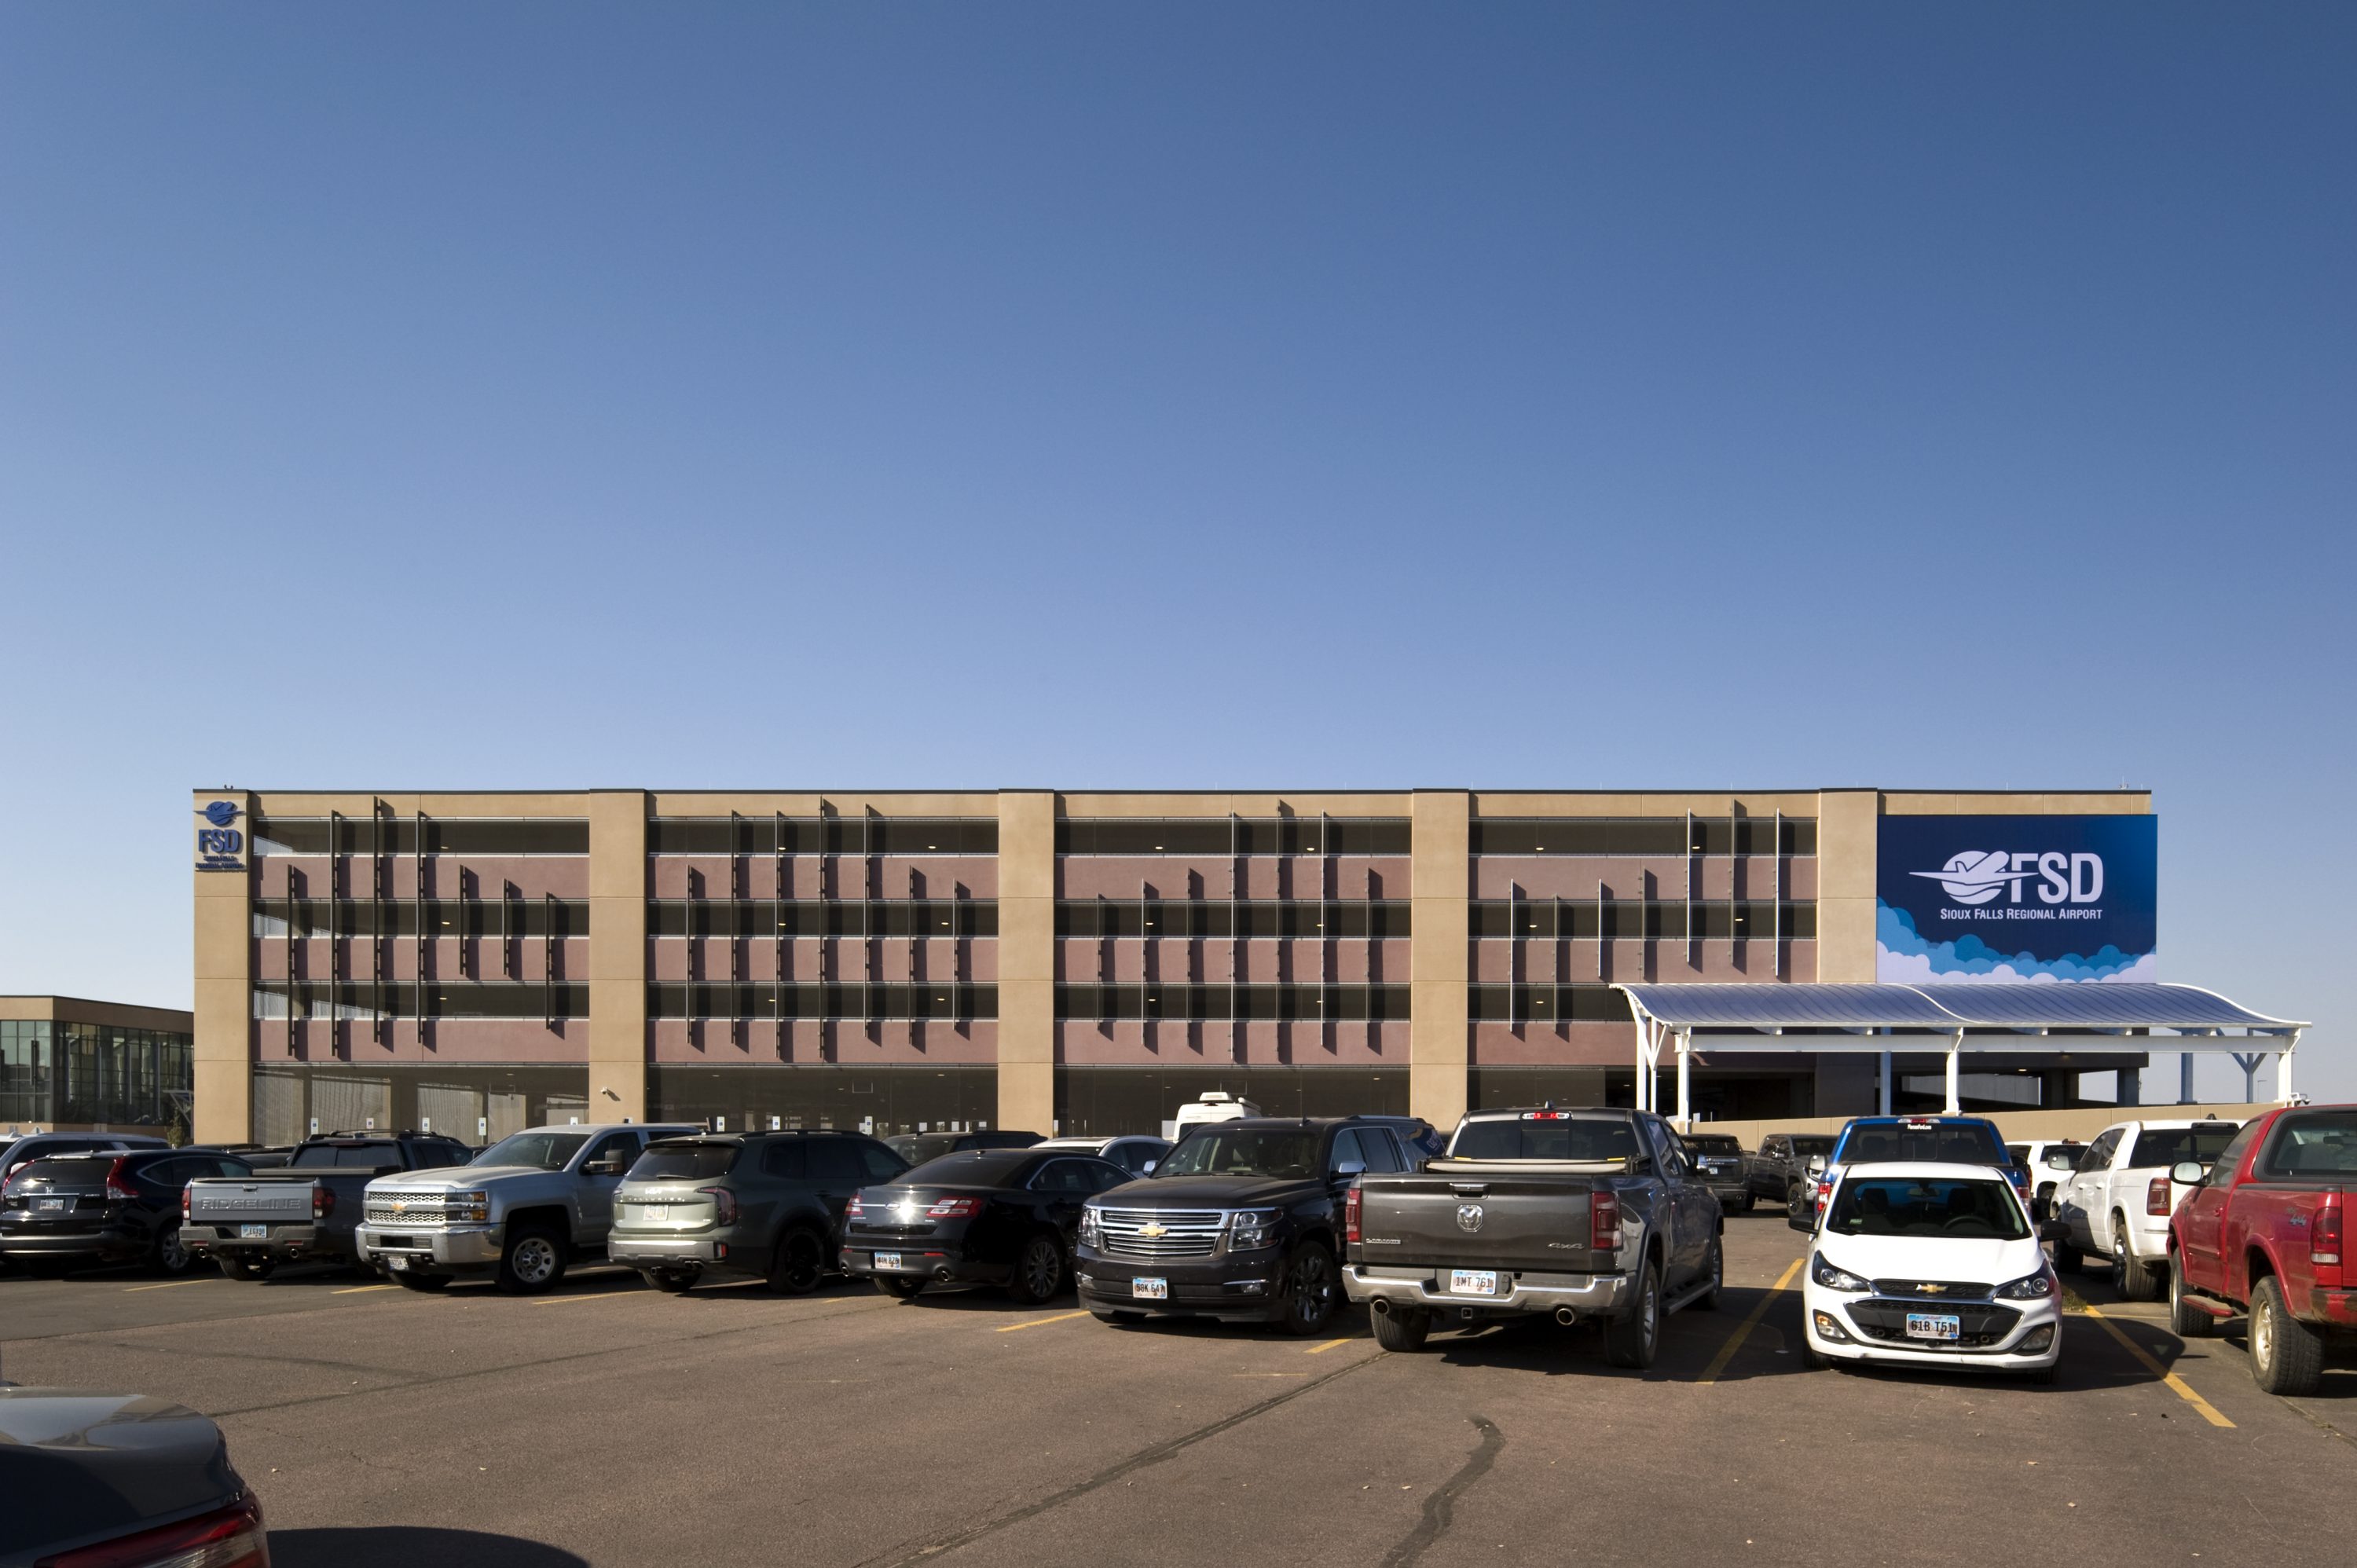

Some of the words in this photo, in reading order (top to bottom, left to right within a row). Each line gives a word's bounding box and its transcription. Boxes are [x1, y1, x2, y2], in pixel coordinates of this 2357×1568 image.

[198, 829, 239, 853] FSD
[2011, 852, 2103, 903] FSD
[200, 1198, 300, 1209] RIDGELINE
[1456, 1277, 1472, 1287] 1MT
[1475, 1277, 1490, 1288] 761
[1935, 1321, 1952, 1332] T51
